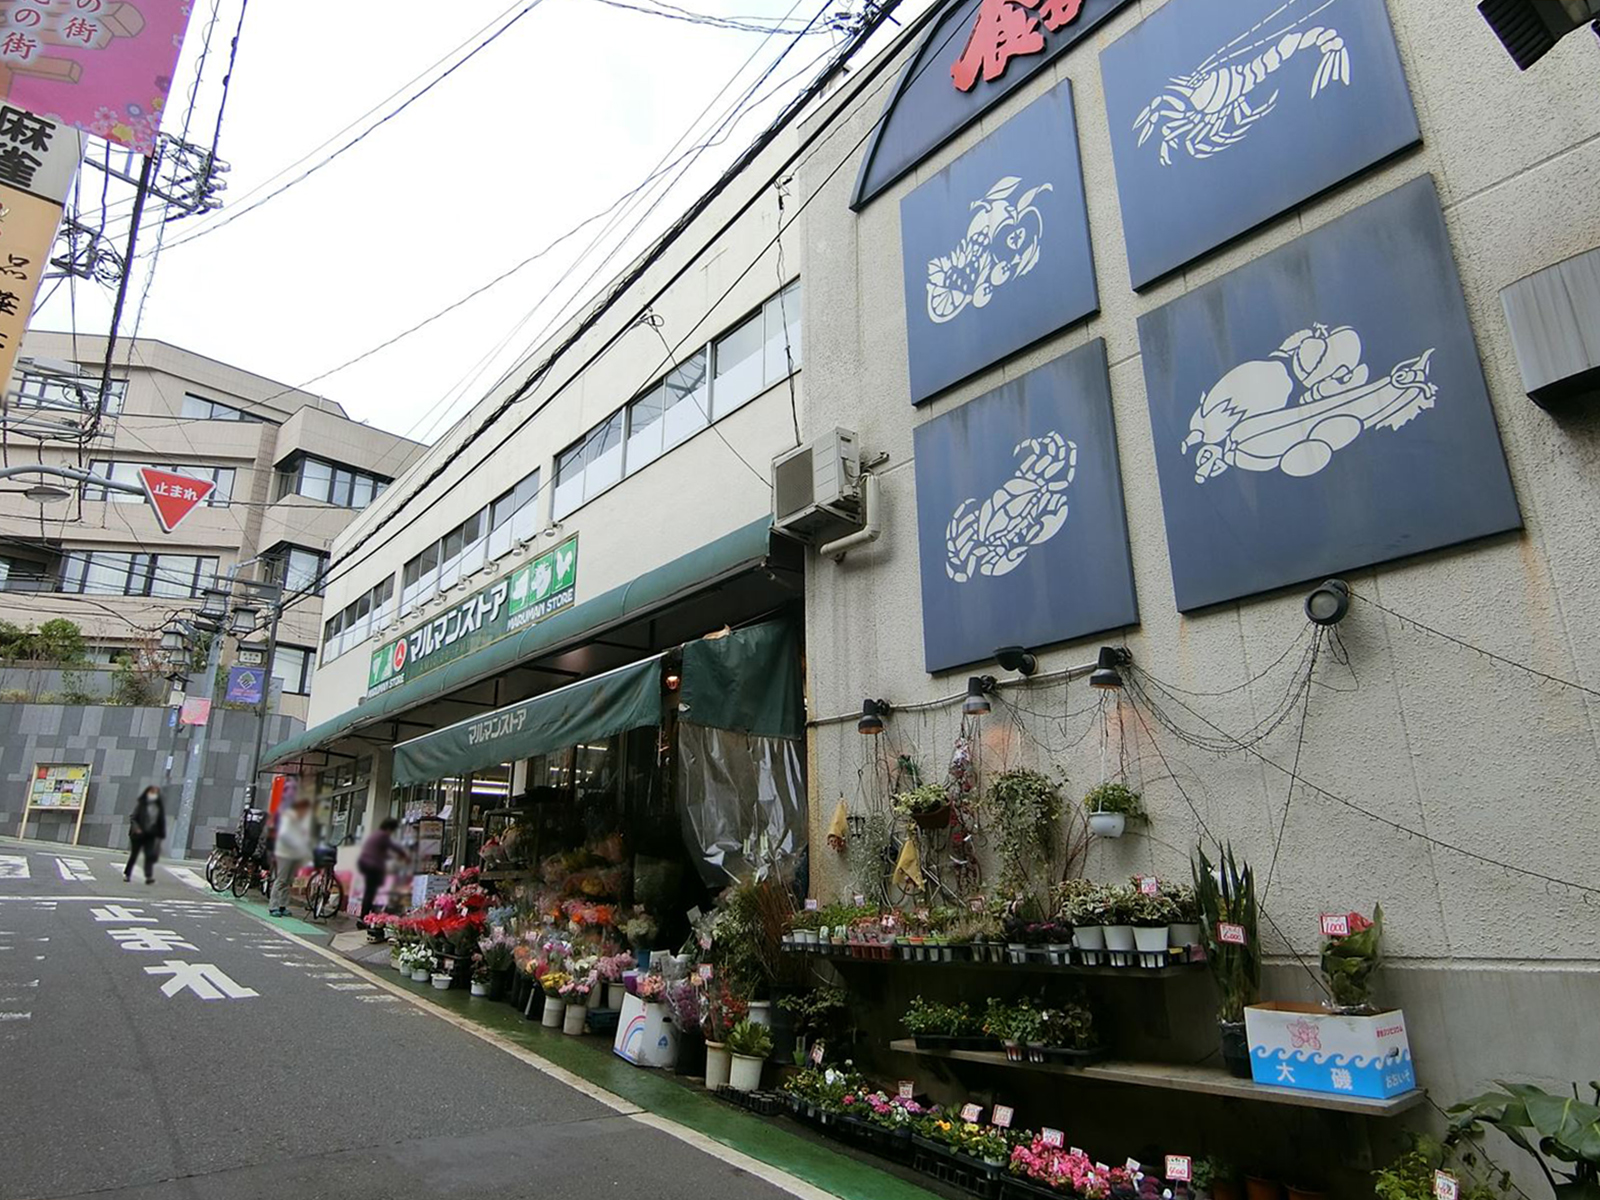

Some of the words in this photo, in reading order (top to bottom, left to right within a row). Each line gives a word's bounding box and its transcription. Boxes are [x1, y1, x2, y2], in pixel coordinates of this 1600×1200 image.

[153, 482, 198, 501] 止まれ
[546, 588, 574, 612] STORE
[410, 580, 508, 663] マルマンストア
[468, 708, 527, 744] マルマンストア
[89, 904, 260, 1000] 止まれ
